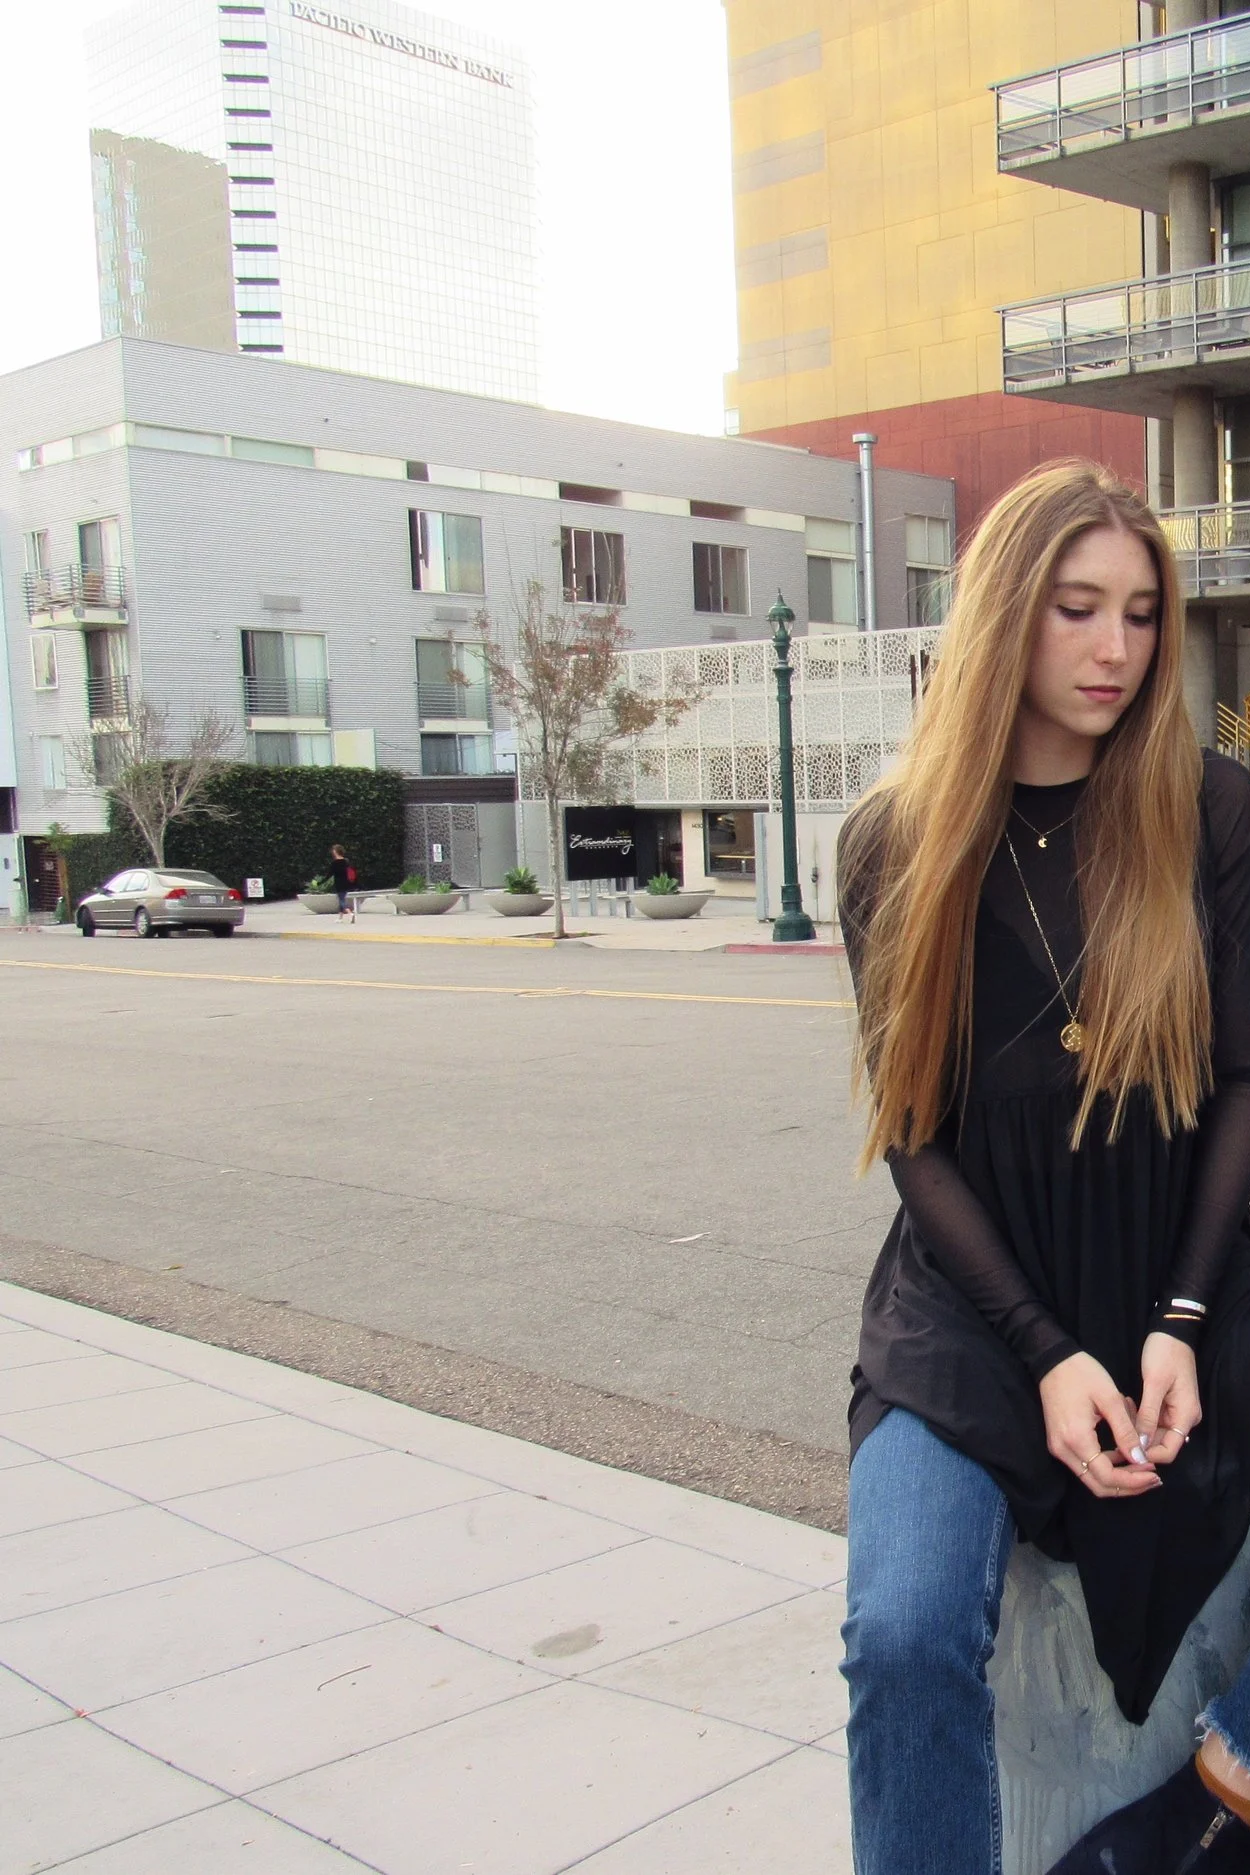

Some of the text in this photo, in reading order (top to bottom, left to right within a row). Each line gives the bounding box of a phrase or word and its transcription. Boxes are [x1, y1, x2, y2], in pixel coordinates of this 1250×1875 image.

[290, 1, 514, 88] PACIFIC WESTERN BANK
